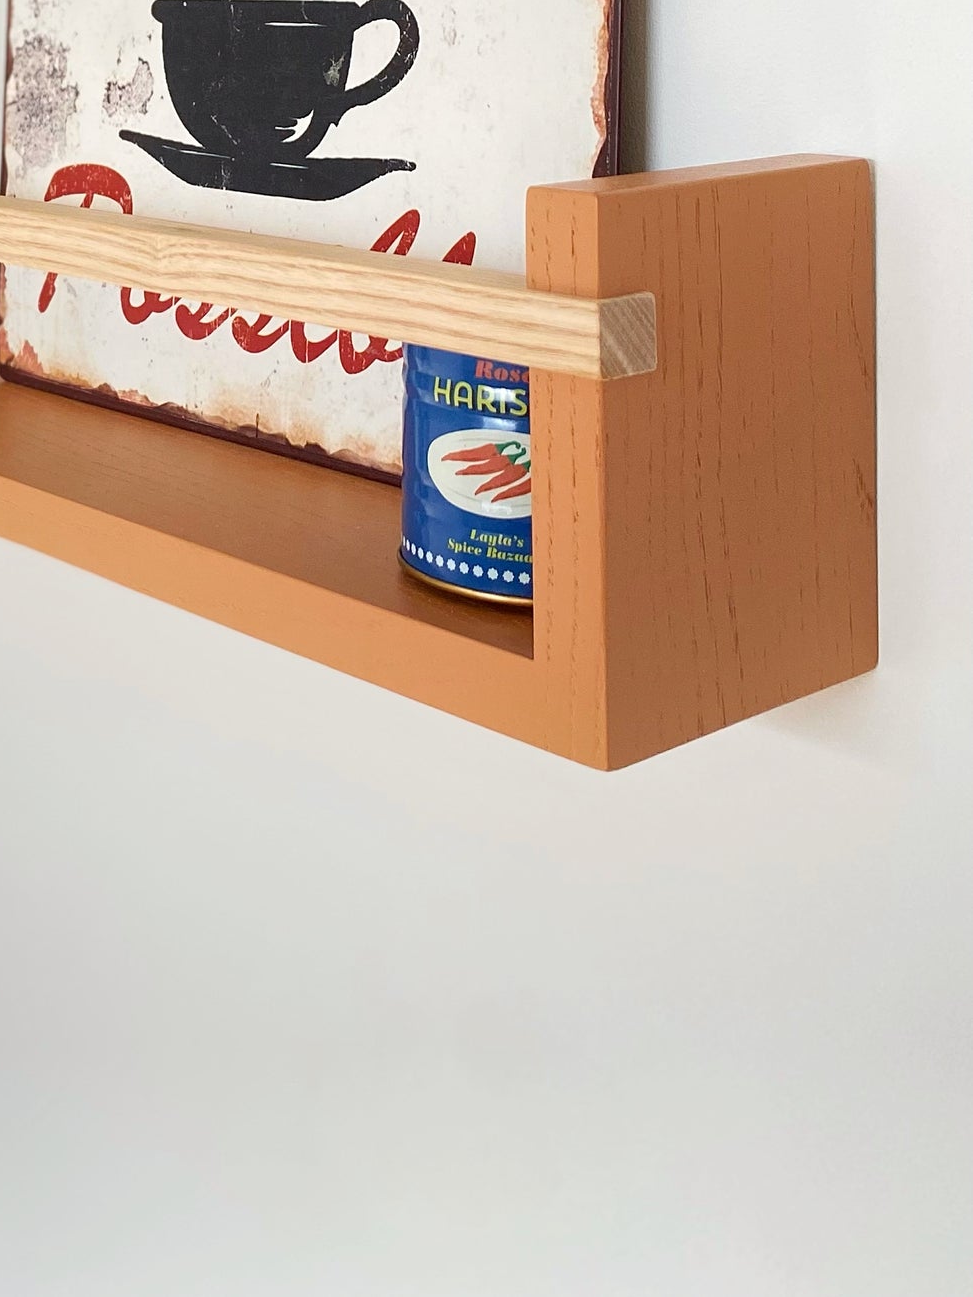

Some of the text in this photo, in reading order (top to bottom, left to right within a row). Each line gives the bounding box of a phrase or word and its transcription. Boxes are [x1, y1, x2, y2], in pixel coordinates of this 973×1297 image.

[433, 375, 528, 417] HARIS
[447, 537, 533, 564] Spice Bazaa
[470, 528, 525, 548] Layla's
